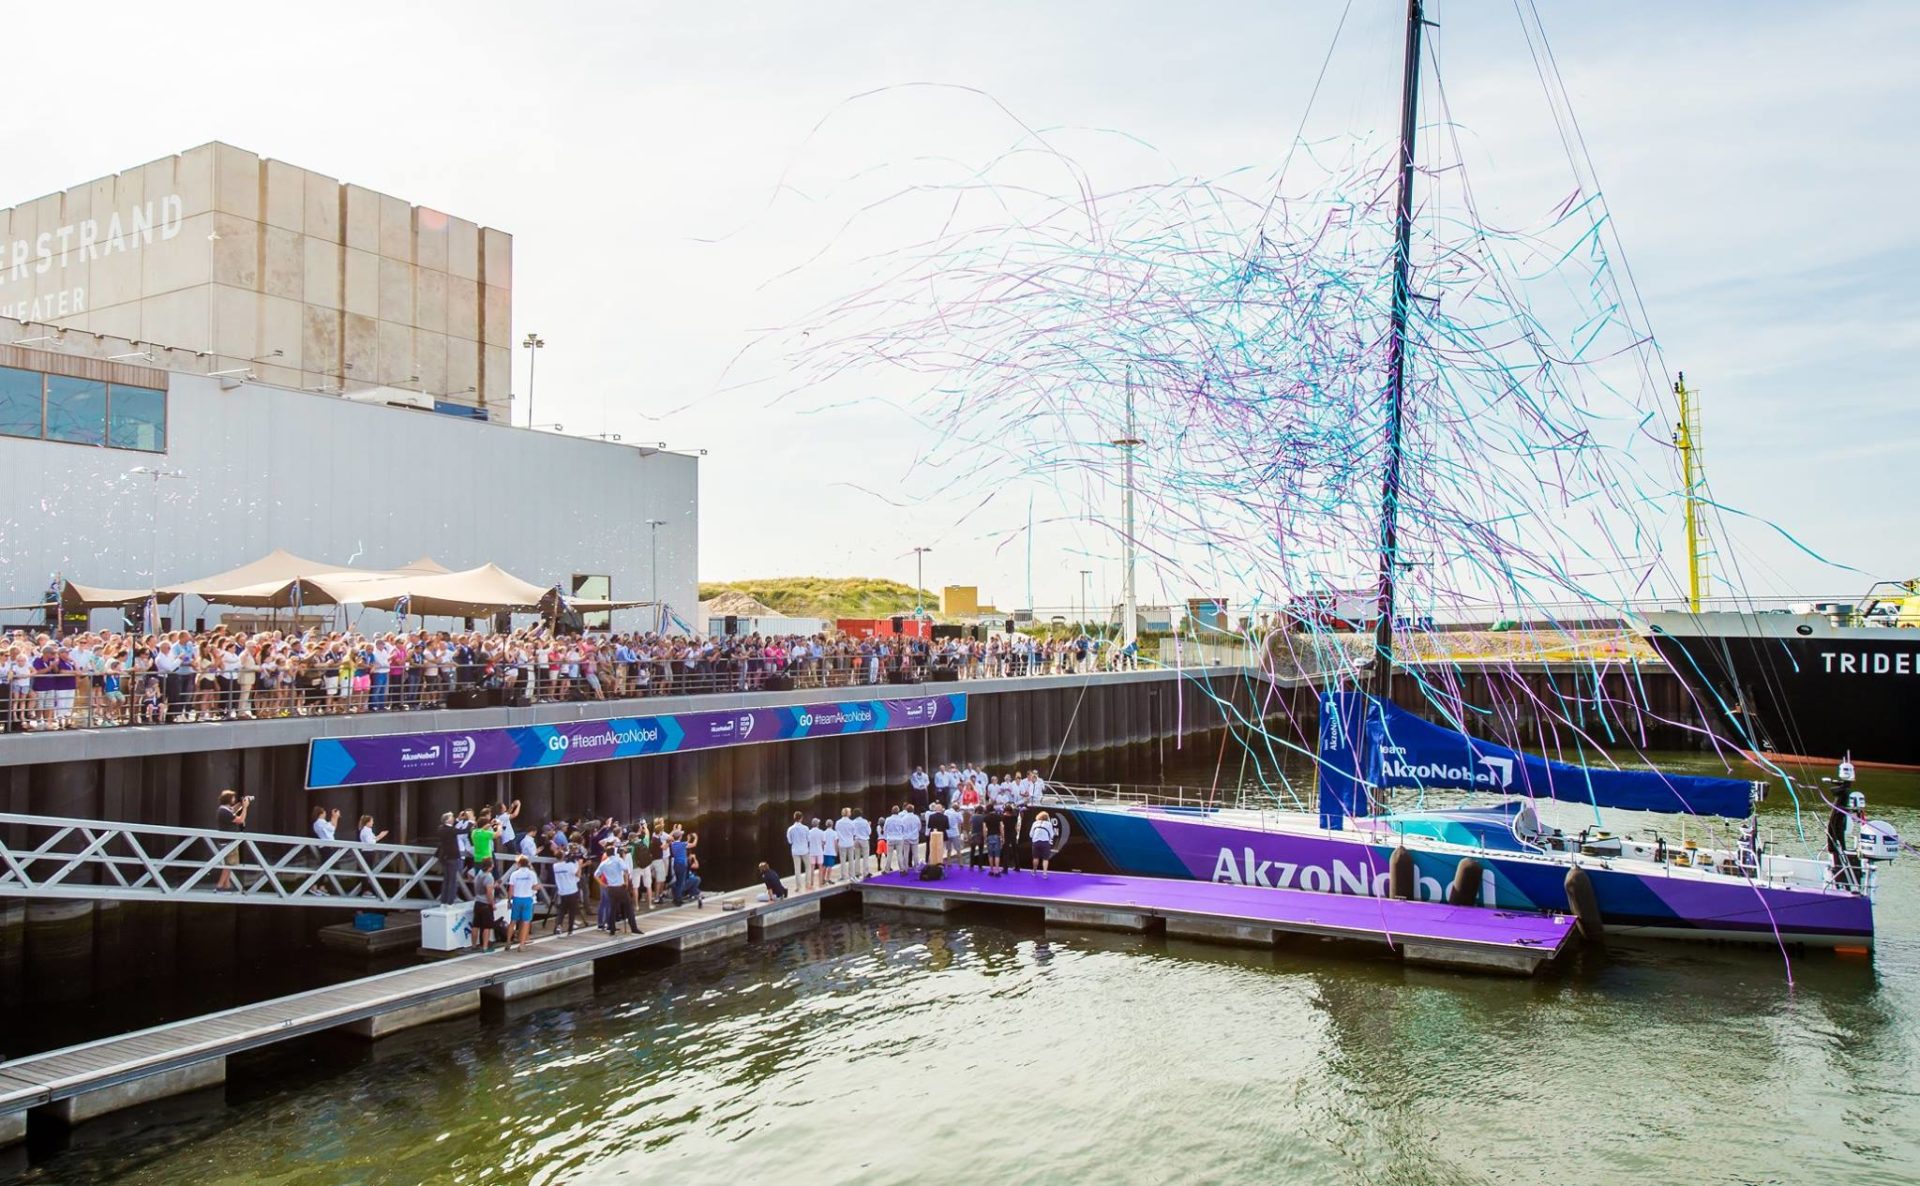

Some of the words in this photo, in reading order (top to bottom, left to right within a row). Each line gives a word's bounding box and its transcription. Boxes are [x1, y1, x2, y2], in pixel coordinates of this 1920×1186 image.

[1821, 652, 1920, 674] TRIDE
[800, 714, 813, 726] GO
[549, 735, 569, 750] GO
[572, 728, 658, 748] #teamAkzoNobel
[1381, 759, 1496, 786] AkzoNobel
